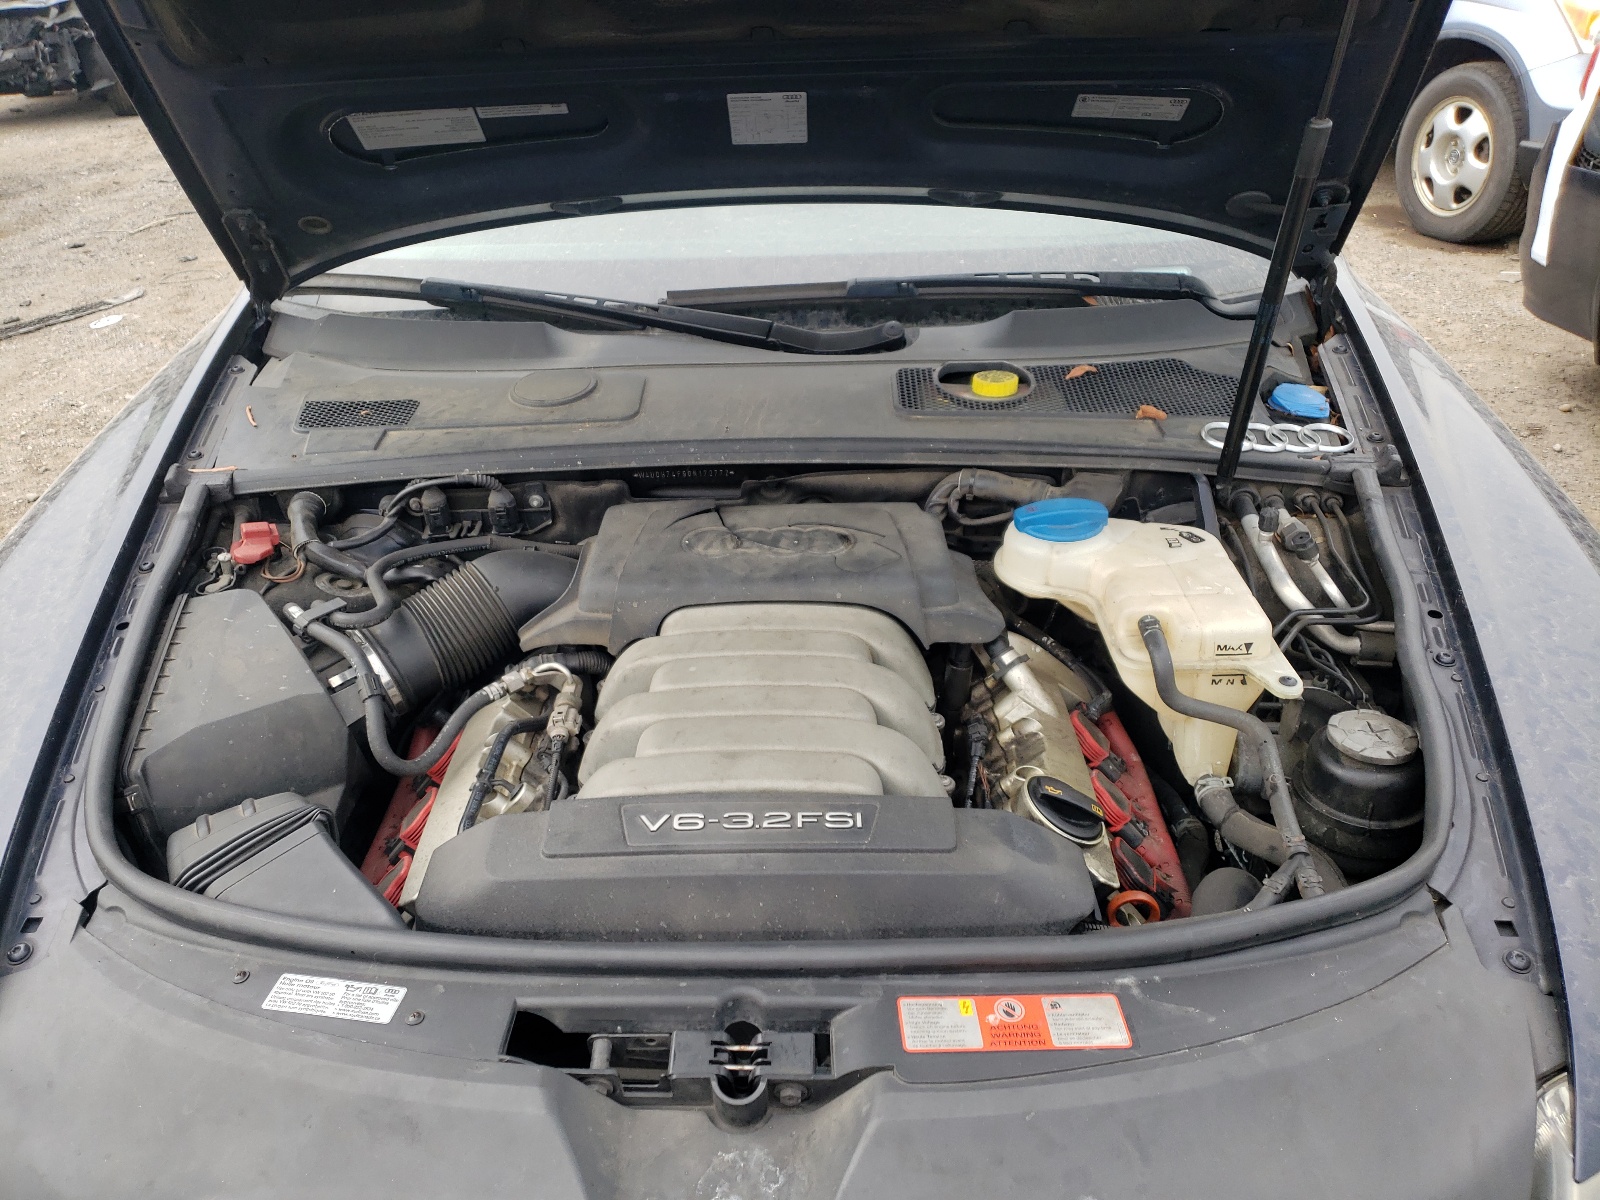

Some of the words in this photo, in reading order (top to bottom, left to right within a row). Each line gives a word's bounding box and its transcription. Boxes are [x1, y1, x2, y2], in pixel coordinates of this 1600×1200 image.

[1211, 678, 1235, 686] MN
[639, 811, 864, 833] V6-3.2FSI
[990, 1038, 1046, 1046] ATTENTION
